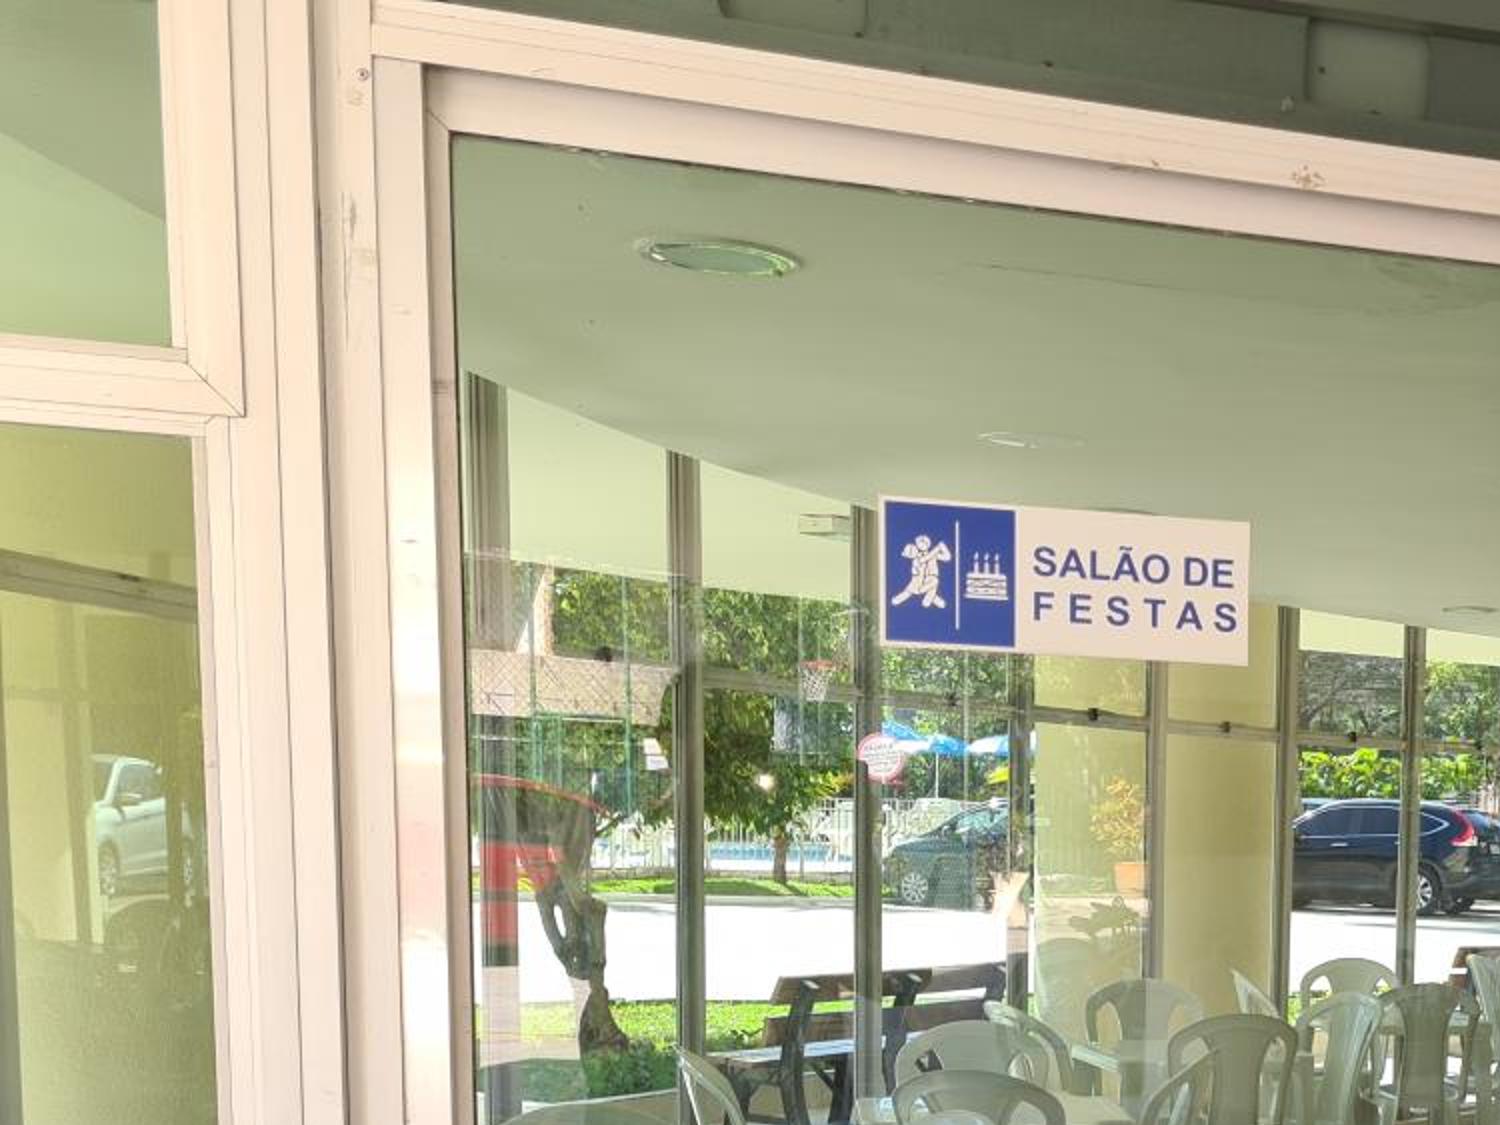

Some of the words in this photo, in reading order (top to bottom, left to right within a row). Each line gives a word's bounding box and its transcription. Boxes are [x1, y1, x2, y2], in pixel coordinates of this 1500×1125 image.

[1033, 545, 1170, 585] SALÃO
[1183, 556, 1235, 589] DE
[1033, 591, 1237, 633] FESTAS
